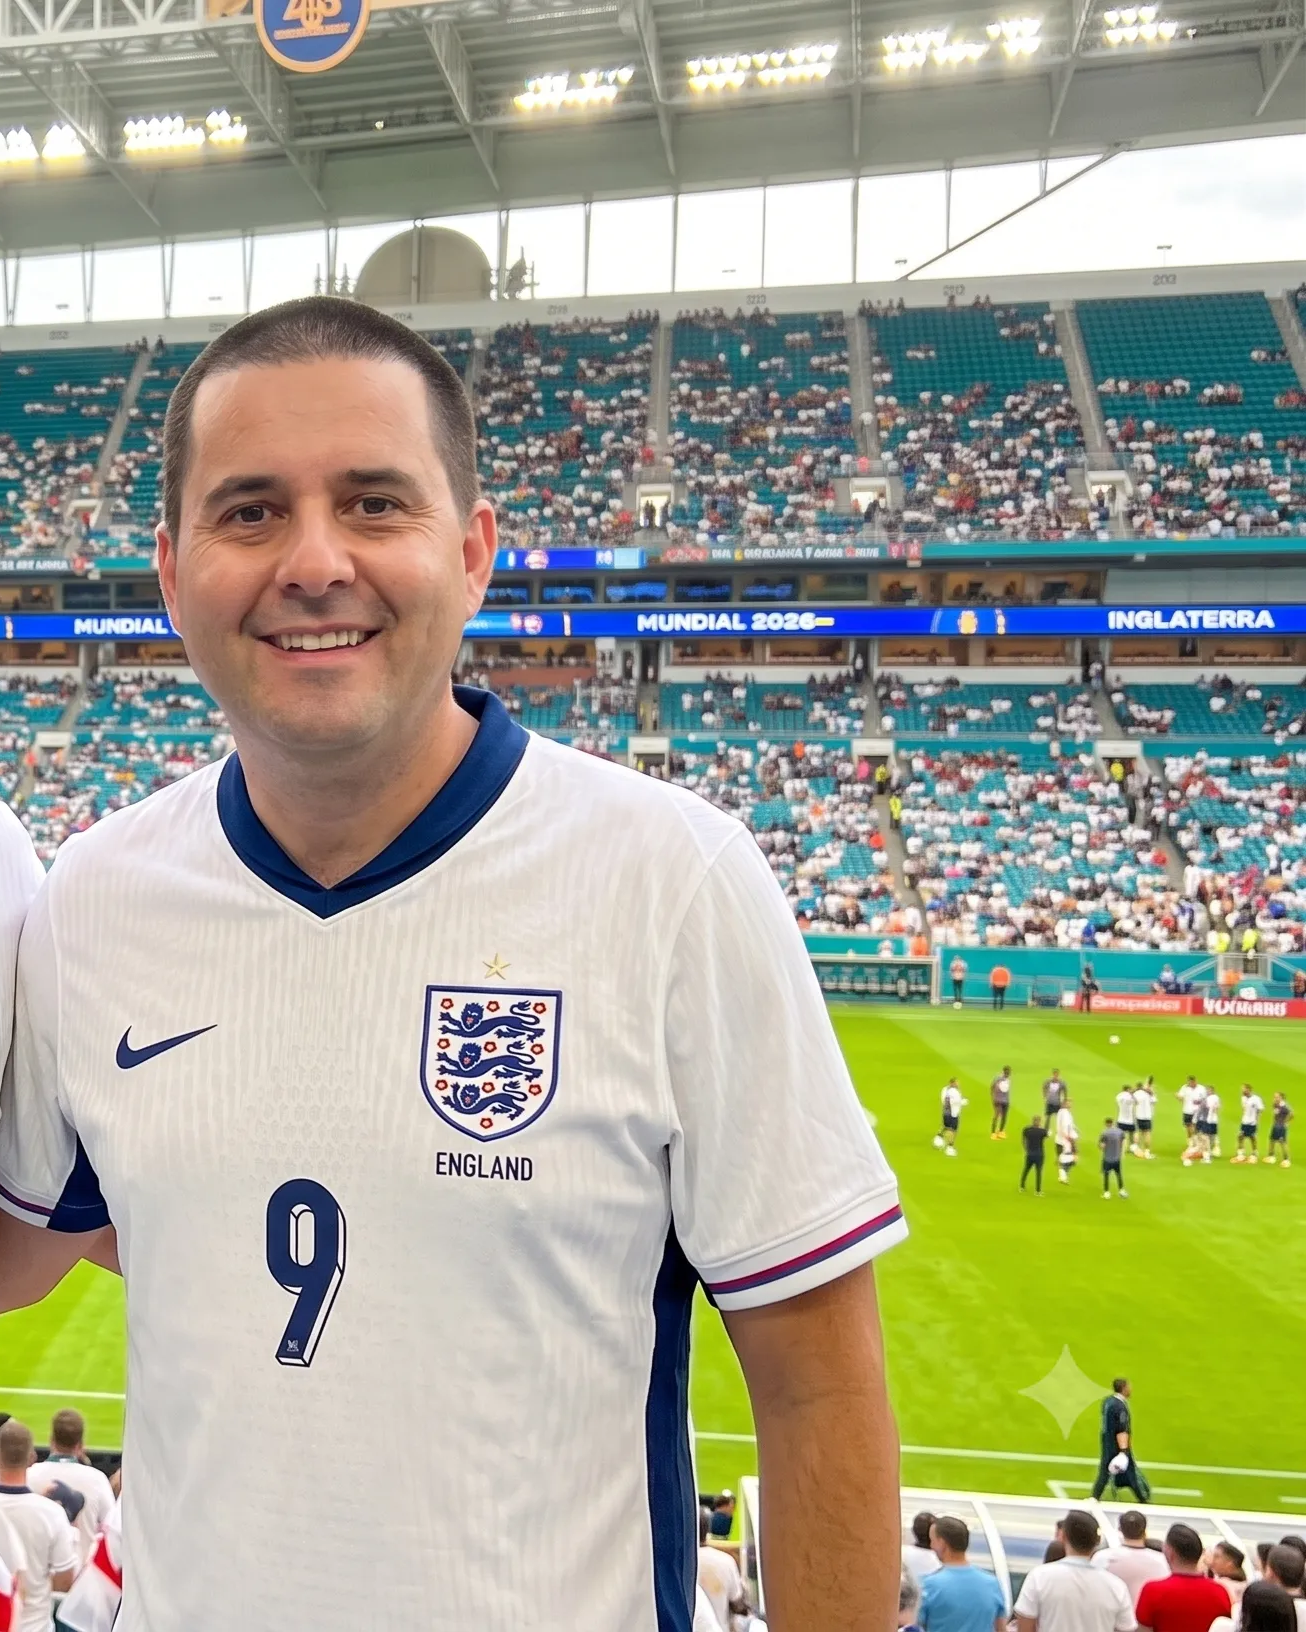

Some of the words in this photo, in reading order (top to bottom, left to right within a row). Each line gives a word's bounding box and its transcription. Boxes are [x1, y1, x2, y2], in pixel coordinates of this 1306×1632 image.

[74, 617, 169, 635] MUNDIAL
[637, 612, 747, 632] MUNDIAL
[751, 612, 816, 631] 2026
[1108, 609, 1275, 630] INGLATERRA
[436, 1152, 533, 1181] ENGLAND
[266, 1178, 347, 1367] 9
